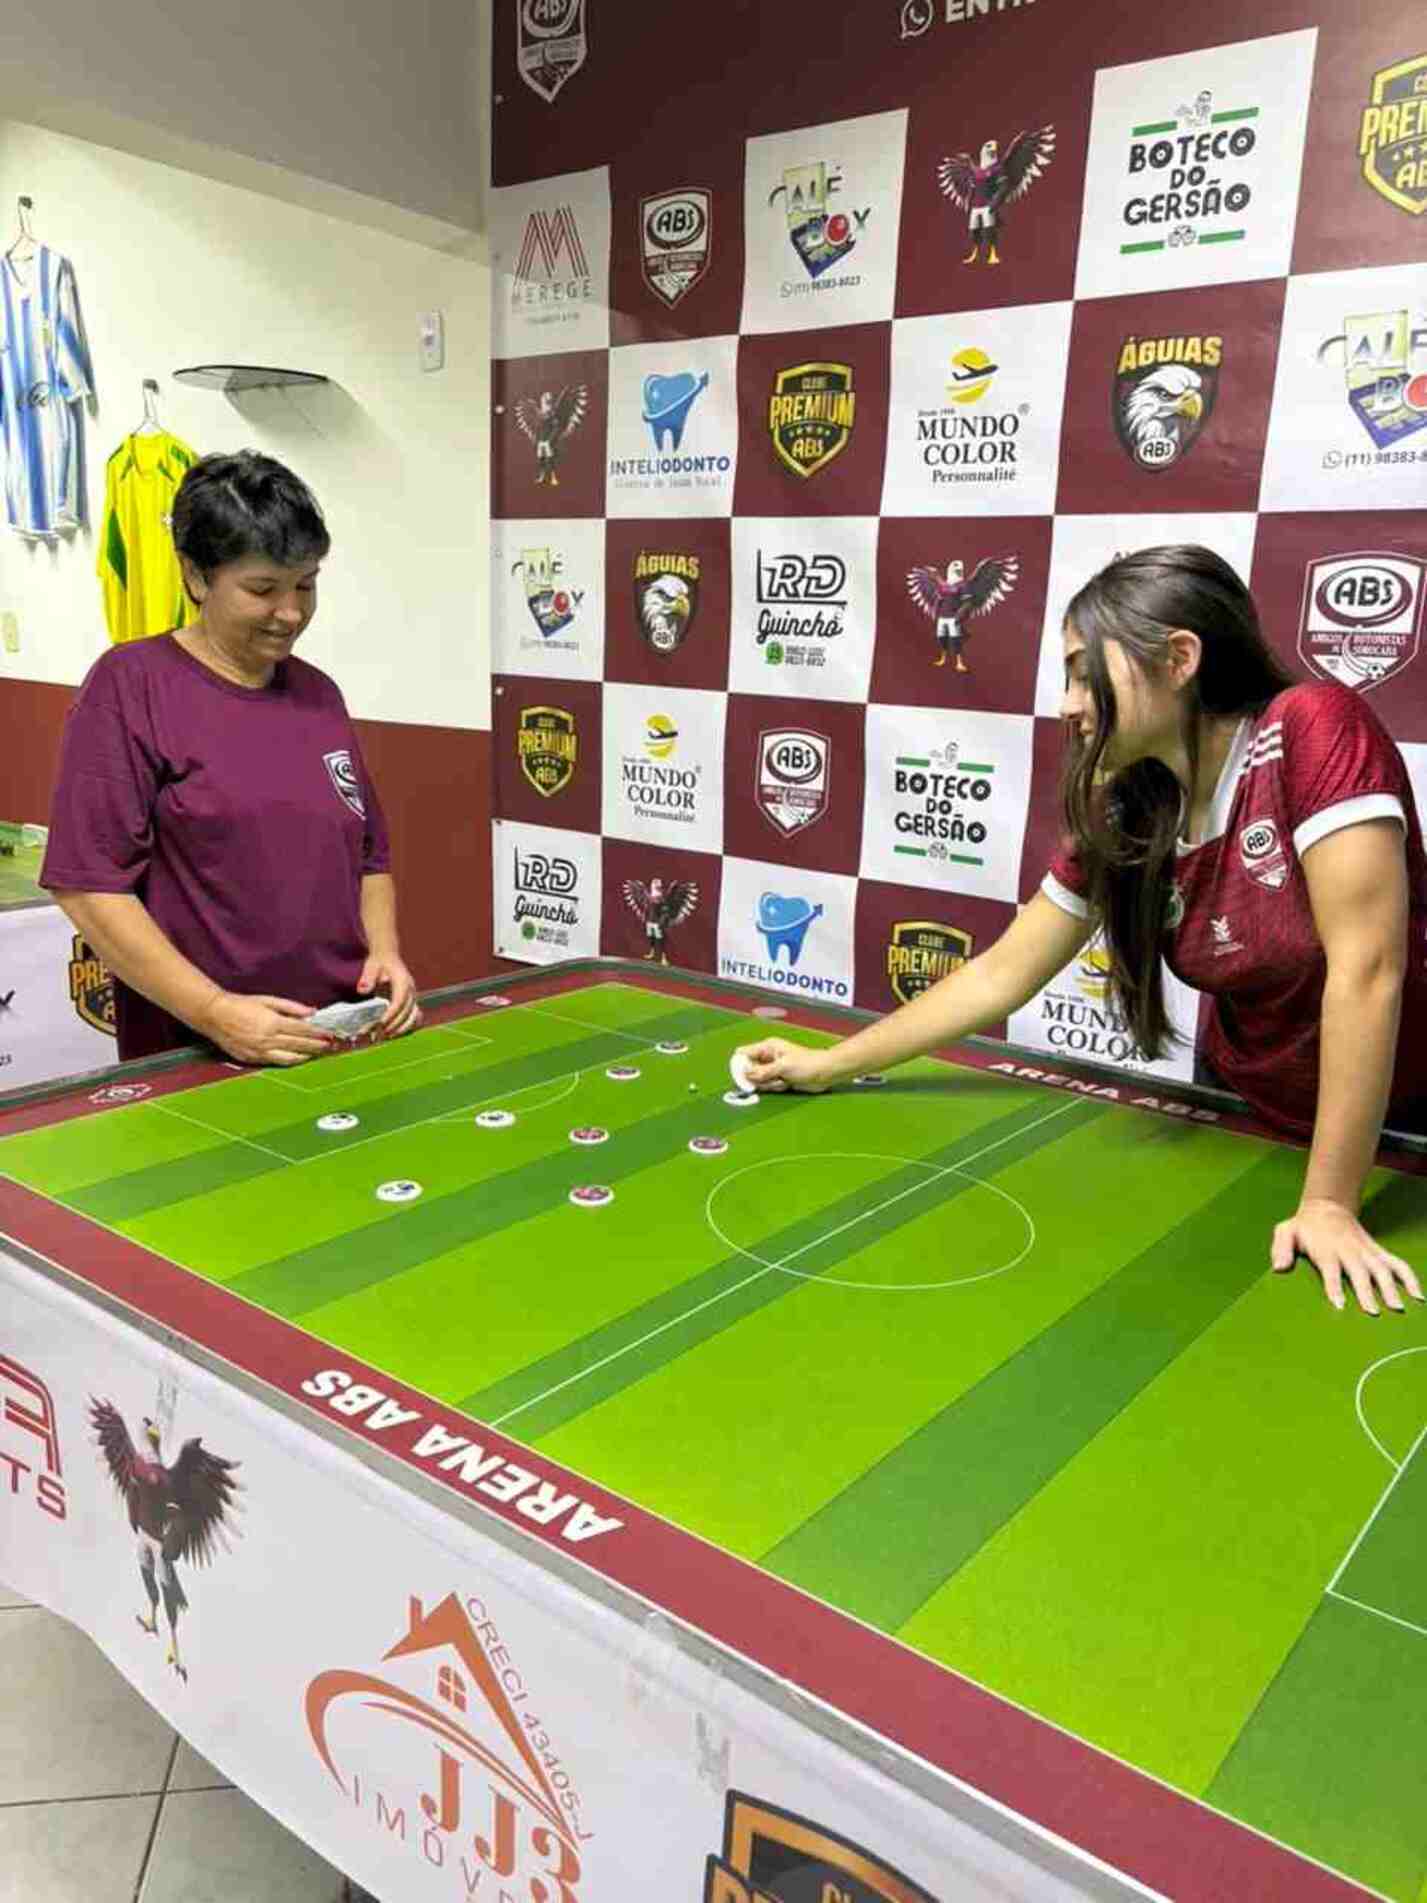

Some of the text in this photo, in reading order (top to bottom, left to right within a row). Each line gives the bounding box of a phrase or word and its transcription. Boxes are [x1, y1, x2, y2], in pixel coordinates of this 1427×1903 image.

[1128, 127, 1256, 174] BOTECO
[1169, 166, 1206, 190] DO
[1123, 178, 1251, 226] GERSÃO
[656, 208, 695, 236] ABS
[1117, 336, 1222, 375] ÁGUIAS
[770, 392, 855, 429] PREMIUM
[917, 414, 1019, 441] MUNDO
[610, 456, 730, 475] INTELIODONTO
[924, 441, 1016, 466] COLOR
[634, 551, 700, 578] ÁGUIAS
[1334, 577, 1394, 607] ABS
[776, 746, 812, 770] ABS
[622, 764, 697, 789] MUNDO
[895, 771, 991, 801] BOTECO
[628, 785, 695, 810] COLOR
[926, 798, 951, 815] DO
[895, 814, 987, 843] GERSÃO
[721, 959, 848, 997] INTELIODONTO
[987, 1062, 1119, 1099] ARENA
[300, 1369, 625, 1542] ARENA ABS
[465, 1597, 528, 1702] CRECI
